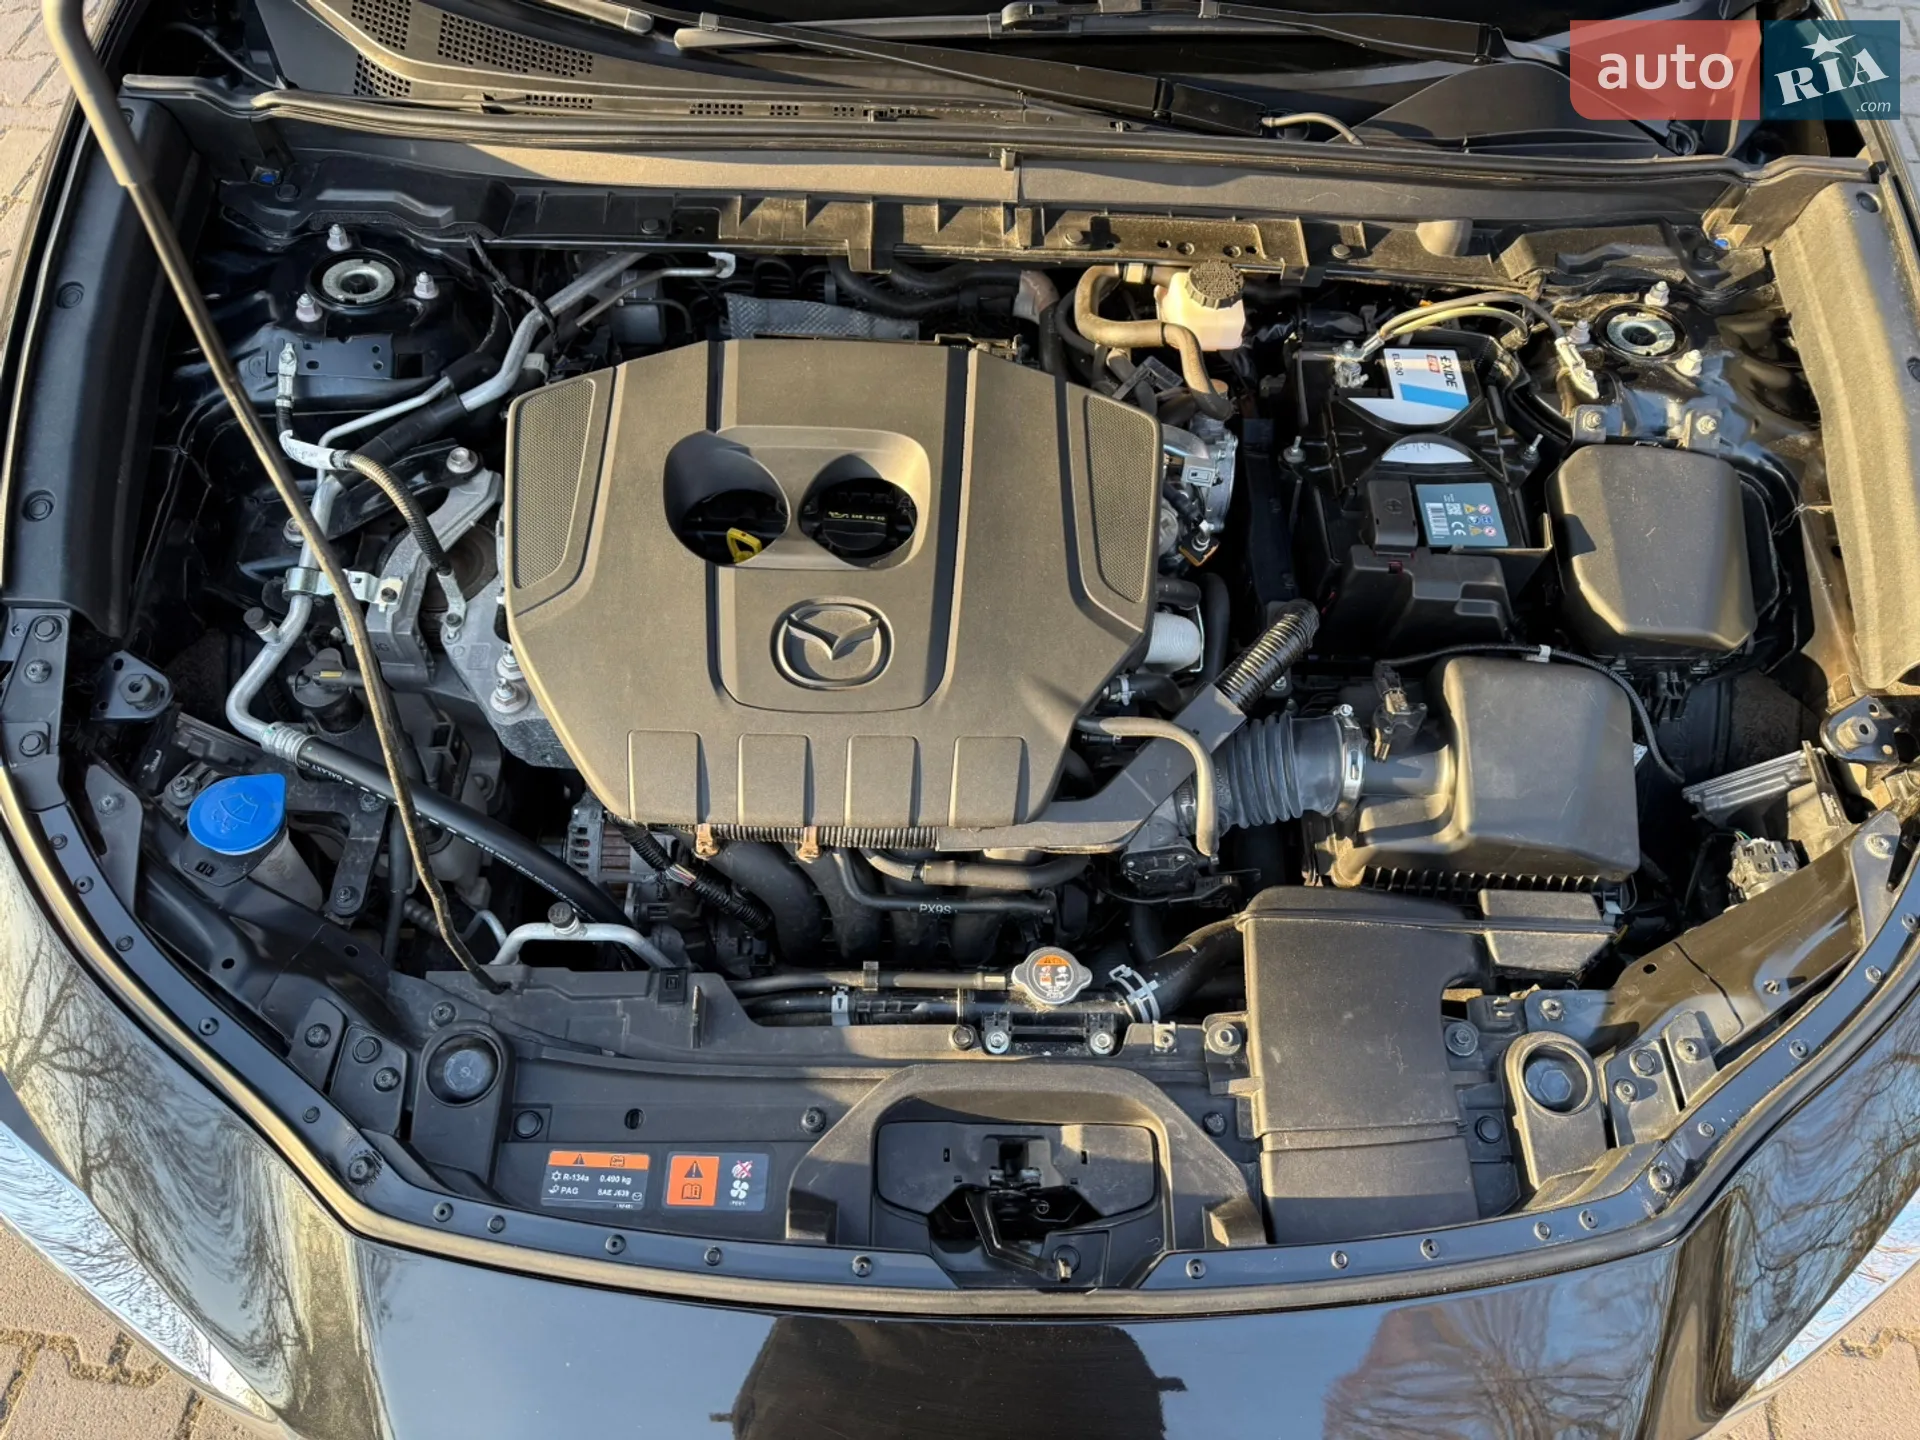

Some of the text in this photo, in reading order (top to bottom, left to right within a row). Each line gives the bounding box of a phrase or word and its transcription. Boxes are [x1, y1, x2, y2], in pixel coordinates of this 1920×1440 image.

[1440, 355, 1457, 388] EXIDE
[312, 765, 343, 781] GALAXY
[562, 1173, 590, 1183] R-134a
[560, 1186, 579, 1195] PAG
[597, 1188, 612, 1196] SAE
